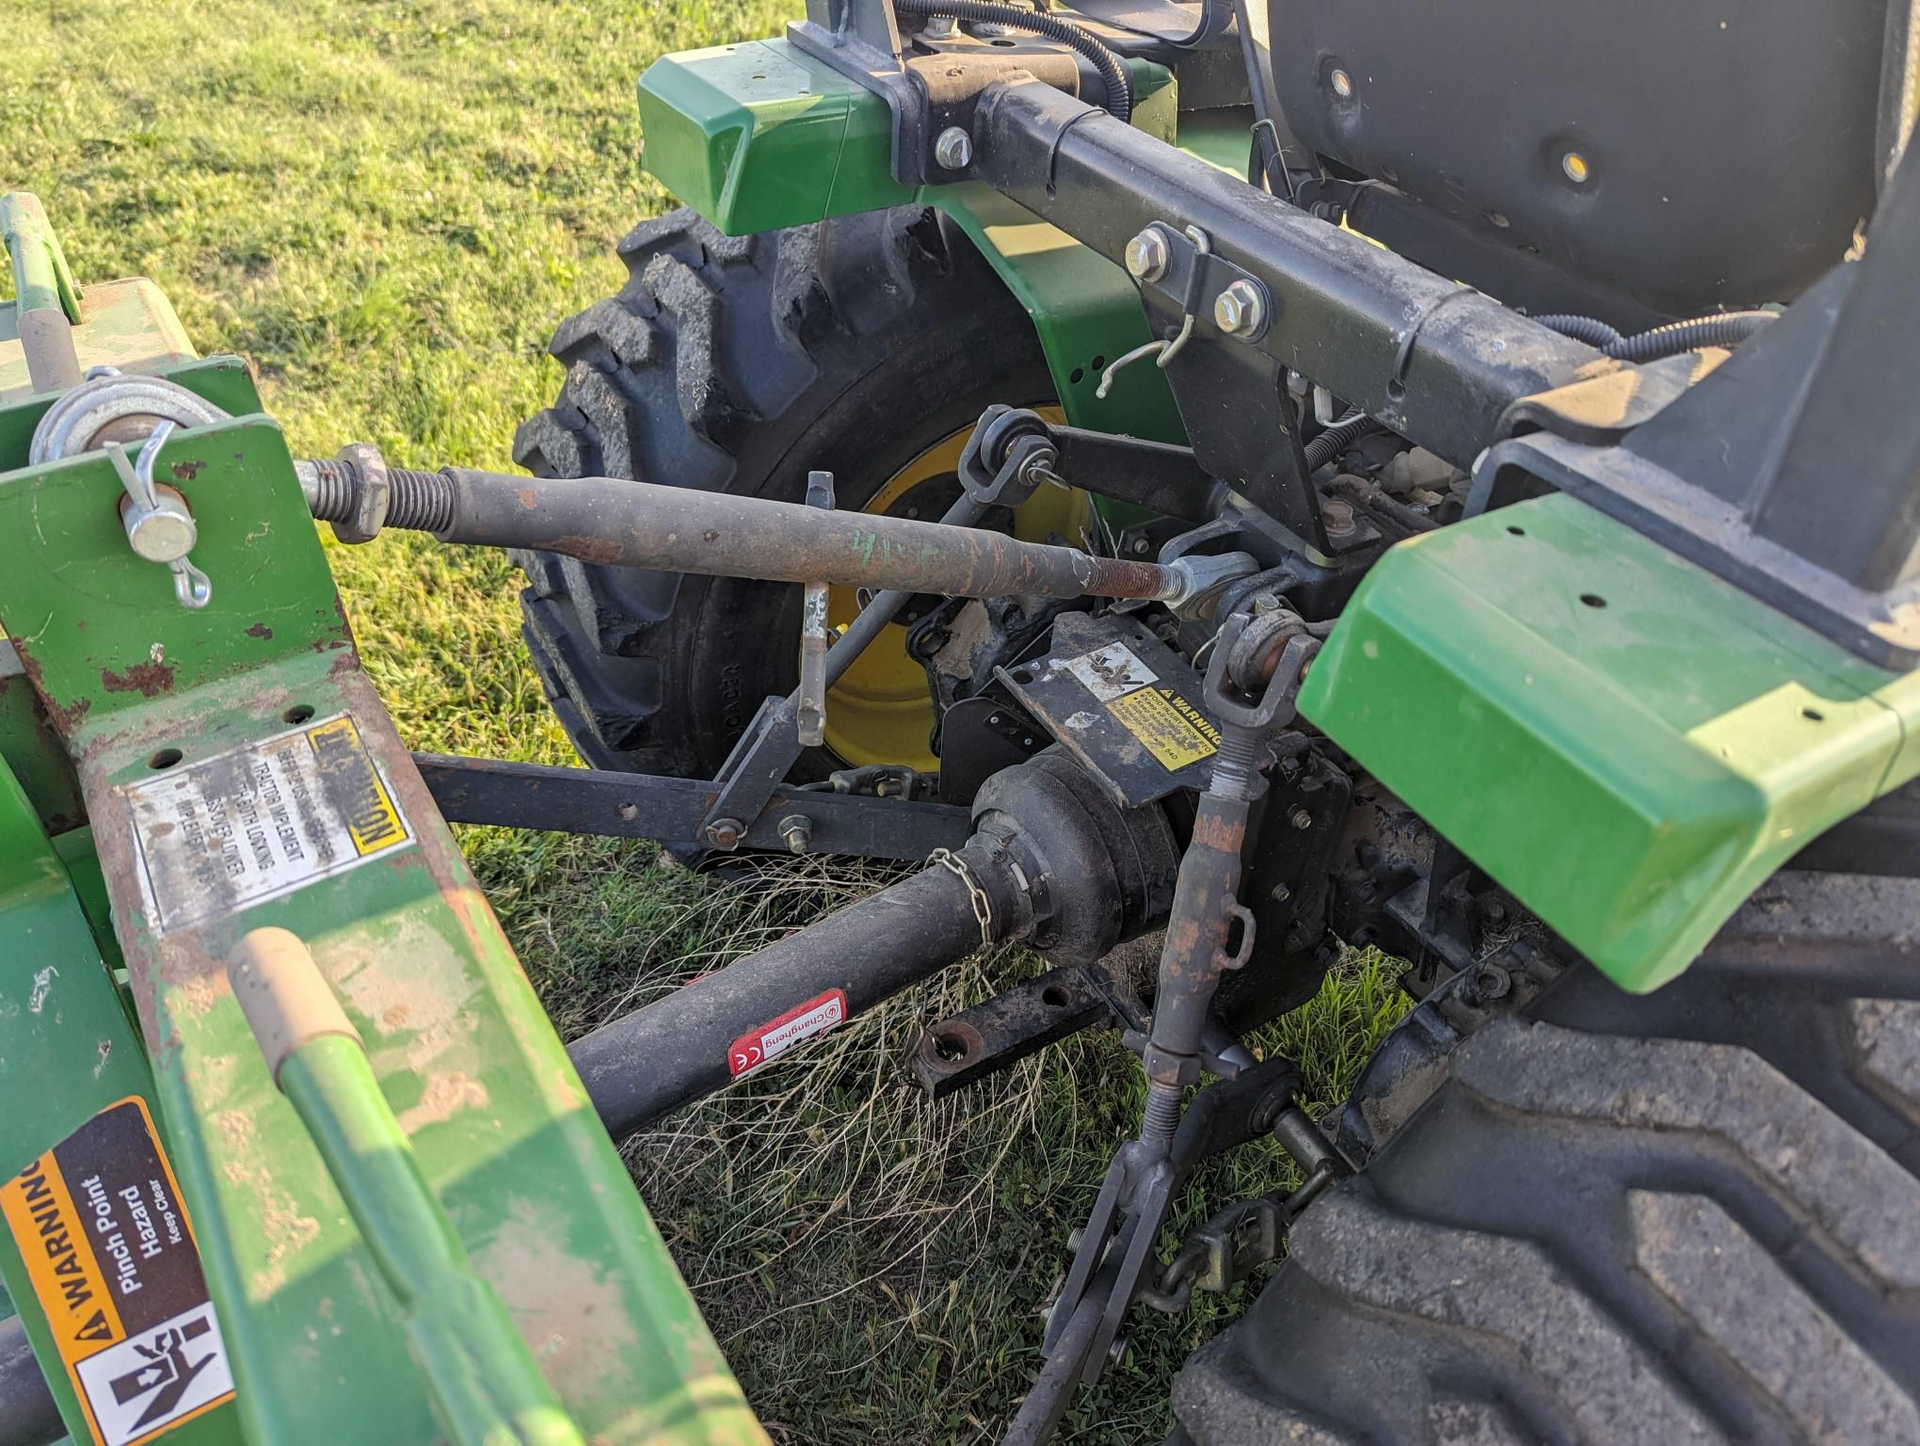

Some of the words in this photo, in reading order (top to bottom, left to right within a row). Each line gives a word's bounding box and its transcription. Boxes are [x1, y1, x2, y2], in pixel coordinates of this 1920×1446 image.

[1171, 696, 1222, 745] WARNING
[1163, 747, 1178, 759] 540
[209, 810, 233, 840] OVER
[236, 797, 260, 827] BOTH
[252, 760, 282, 805] TRACTOR
[268, 802, 305, 863] IMPLEMENT
[218, 837, 246, 878] LOWER
[246, 825, 276, 871] LOCKING
[764, 1013, 825, 1048] Changheng
[81, 1174, 118, 1233] Point
[148, 1179, 169, 1211] Clear
[118, 1184, 163, 1259] Hazard
[162, 1211, 182, 1245] Keep
[106, 1232, 143, 1295] Pinch
